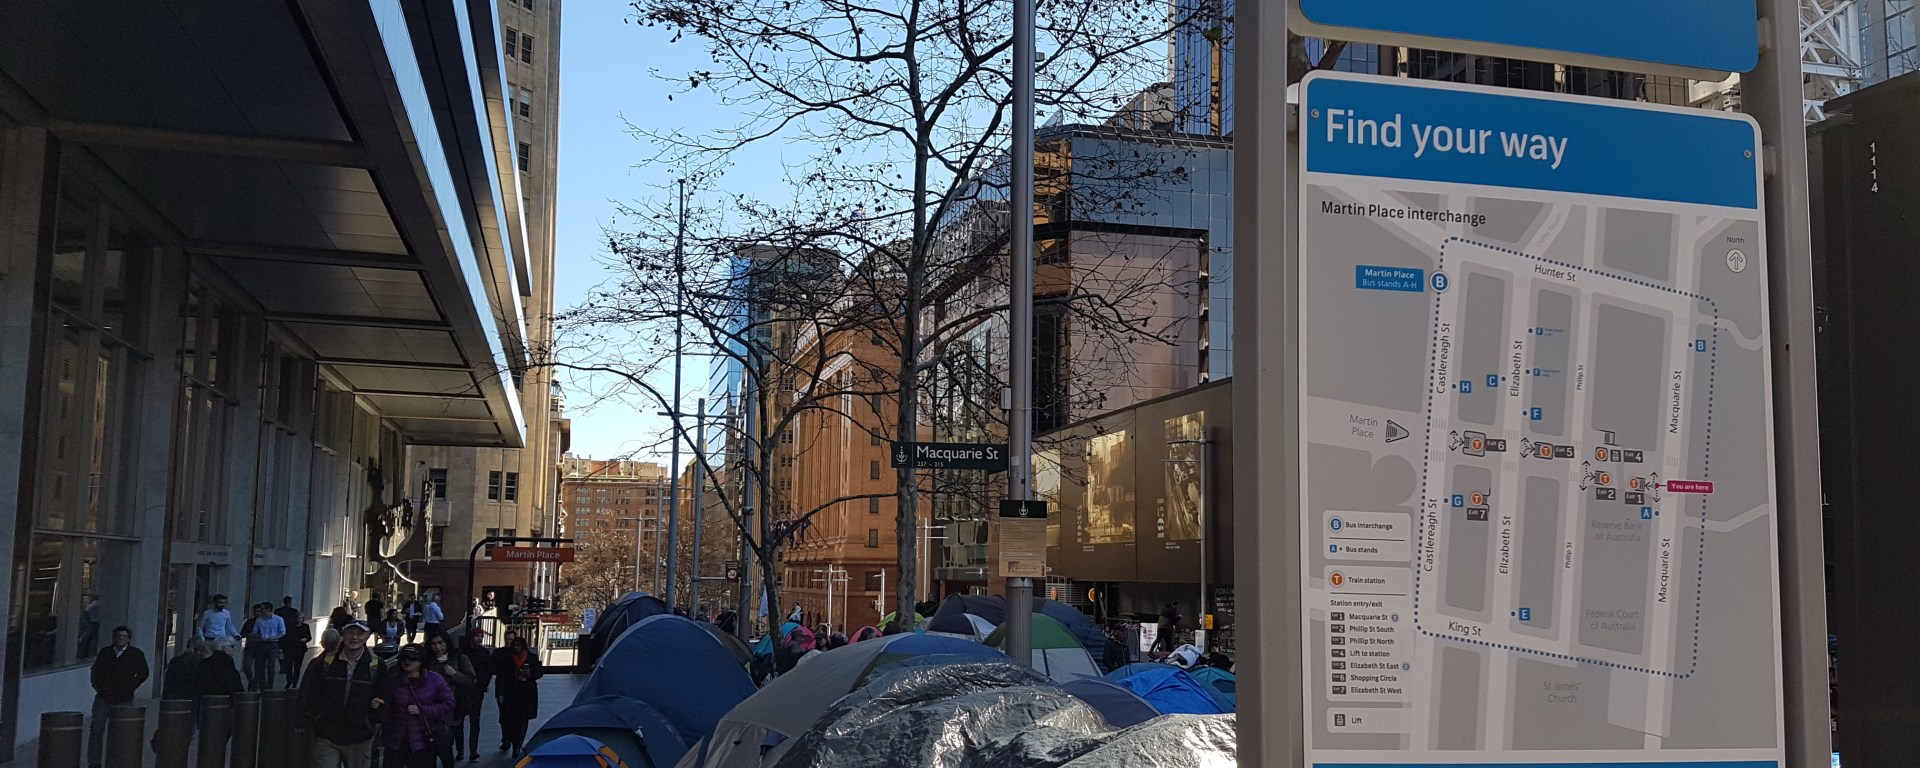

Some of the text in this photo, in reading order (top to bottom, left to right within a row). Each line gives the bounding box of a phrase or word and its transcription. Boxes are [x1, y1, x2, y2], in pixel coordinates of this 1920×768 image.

[1327, 108, 1568, 170] Find your way
[1321, 200, 1486, 227] Martin Place interchange
[1726, 235, 1745, 245] North
[1364, 268, 1415, 279] Martin Place
[1534, 263, 1576, 282] Hunter St
[1362, 279, 1376, 287] Bus
[1436, 277, 1444, 288] B
[1436, 322, 1451, 394] Castlereagh St
[1510, 340, 1523, 397] Elizabeth St
[1576, 372, 1585, 391] Phillip
[1462, 382, 1470, 392] H
[1670, 370, 1682, 434] Macquarie St
[1349, 414, 1378, 427] Martin
[1351, 427, 1374, 438] Place
[1498, 441, 1505, 451] 6
[916, 445, 999, 462] Macquarie St
[1566, 447, 1573, 457] 5
[1635, 452, 1642, 462] 4
[1607, 490, 1615, 499] 2
[1454, 496, 1462, 506] G
[1480, 510, 1486, 520] 7
[1358, 522, 1393, 530] interchange
[1424, 498, 1438, 572] Castlereagh St
[1606, 533, 1641, 542] Australia
[1499, 516, 1511, 574] Elizabeth St
[506, 550, 560, 560] Martin Place
[1565, 550, 1573, 568] Phillip
[1658, 538, 1671, 603] Macquarie St
[1364, 577, 1386, 585] station
[1349, 613, 1381, 621] Macquarie
[1521, 609, 1528, 619] E
[1349, 625, 1368, 633] Phillip
[1448, 621, 1482, 637] King St
[1601, 622, 1636, 631] Australia
[1349, 637, 1368, 646] Phillip
[1350, 674, 1379, 683] Shopping
[1350, 686, 1379, 694] Elizabeth
[1379, 686, 1386, 694] St
